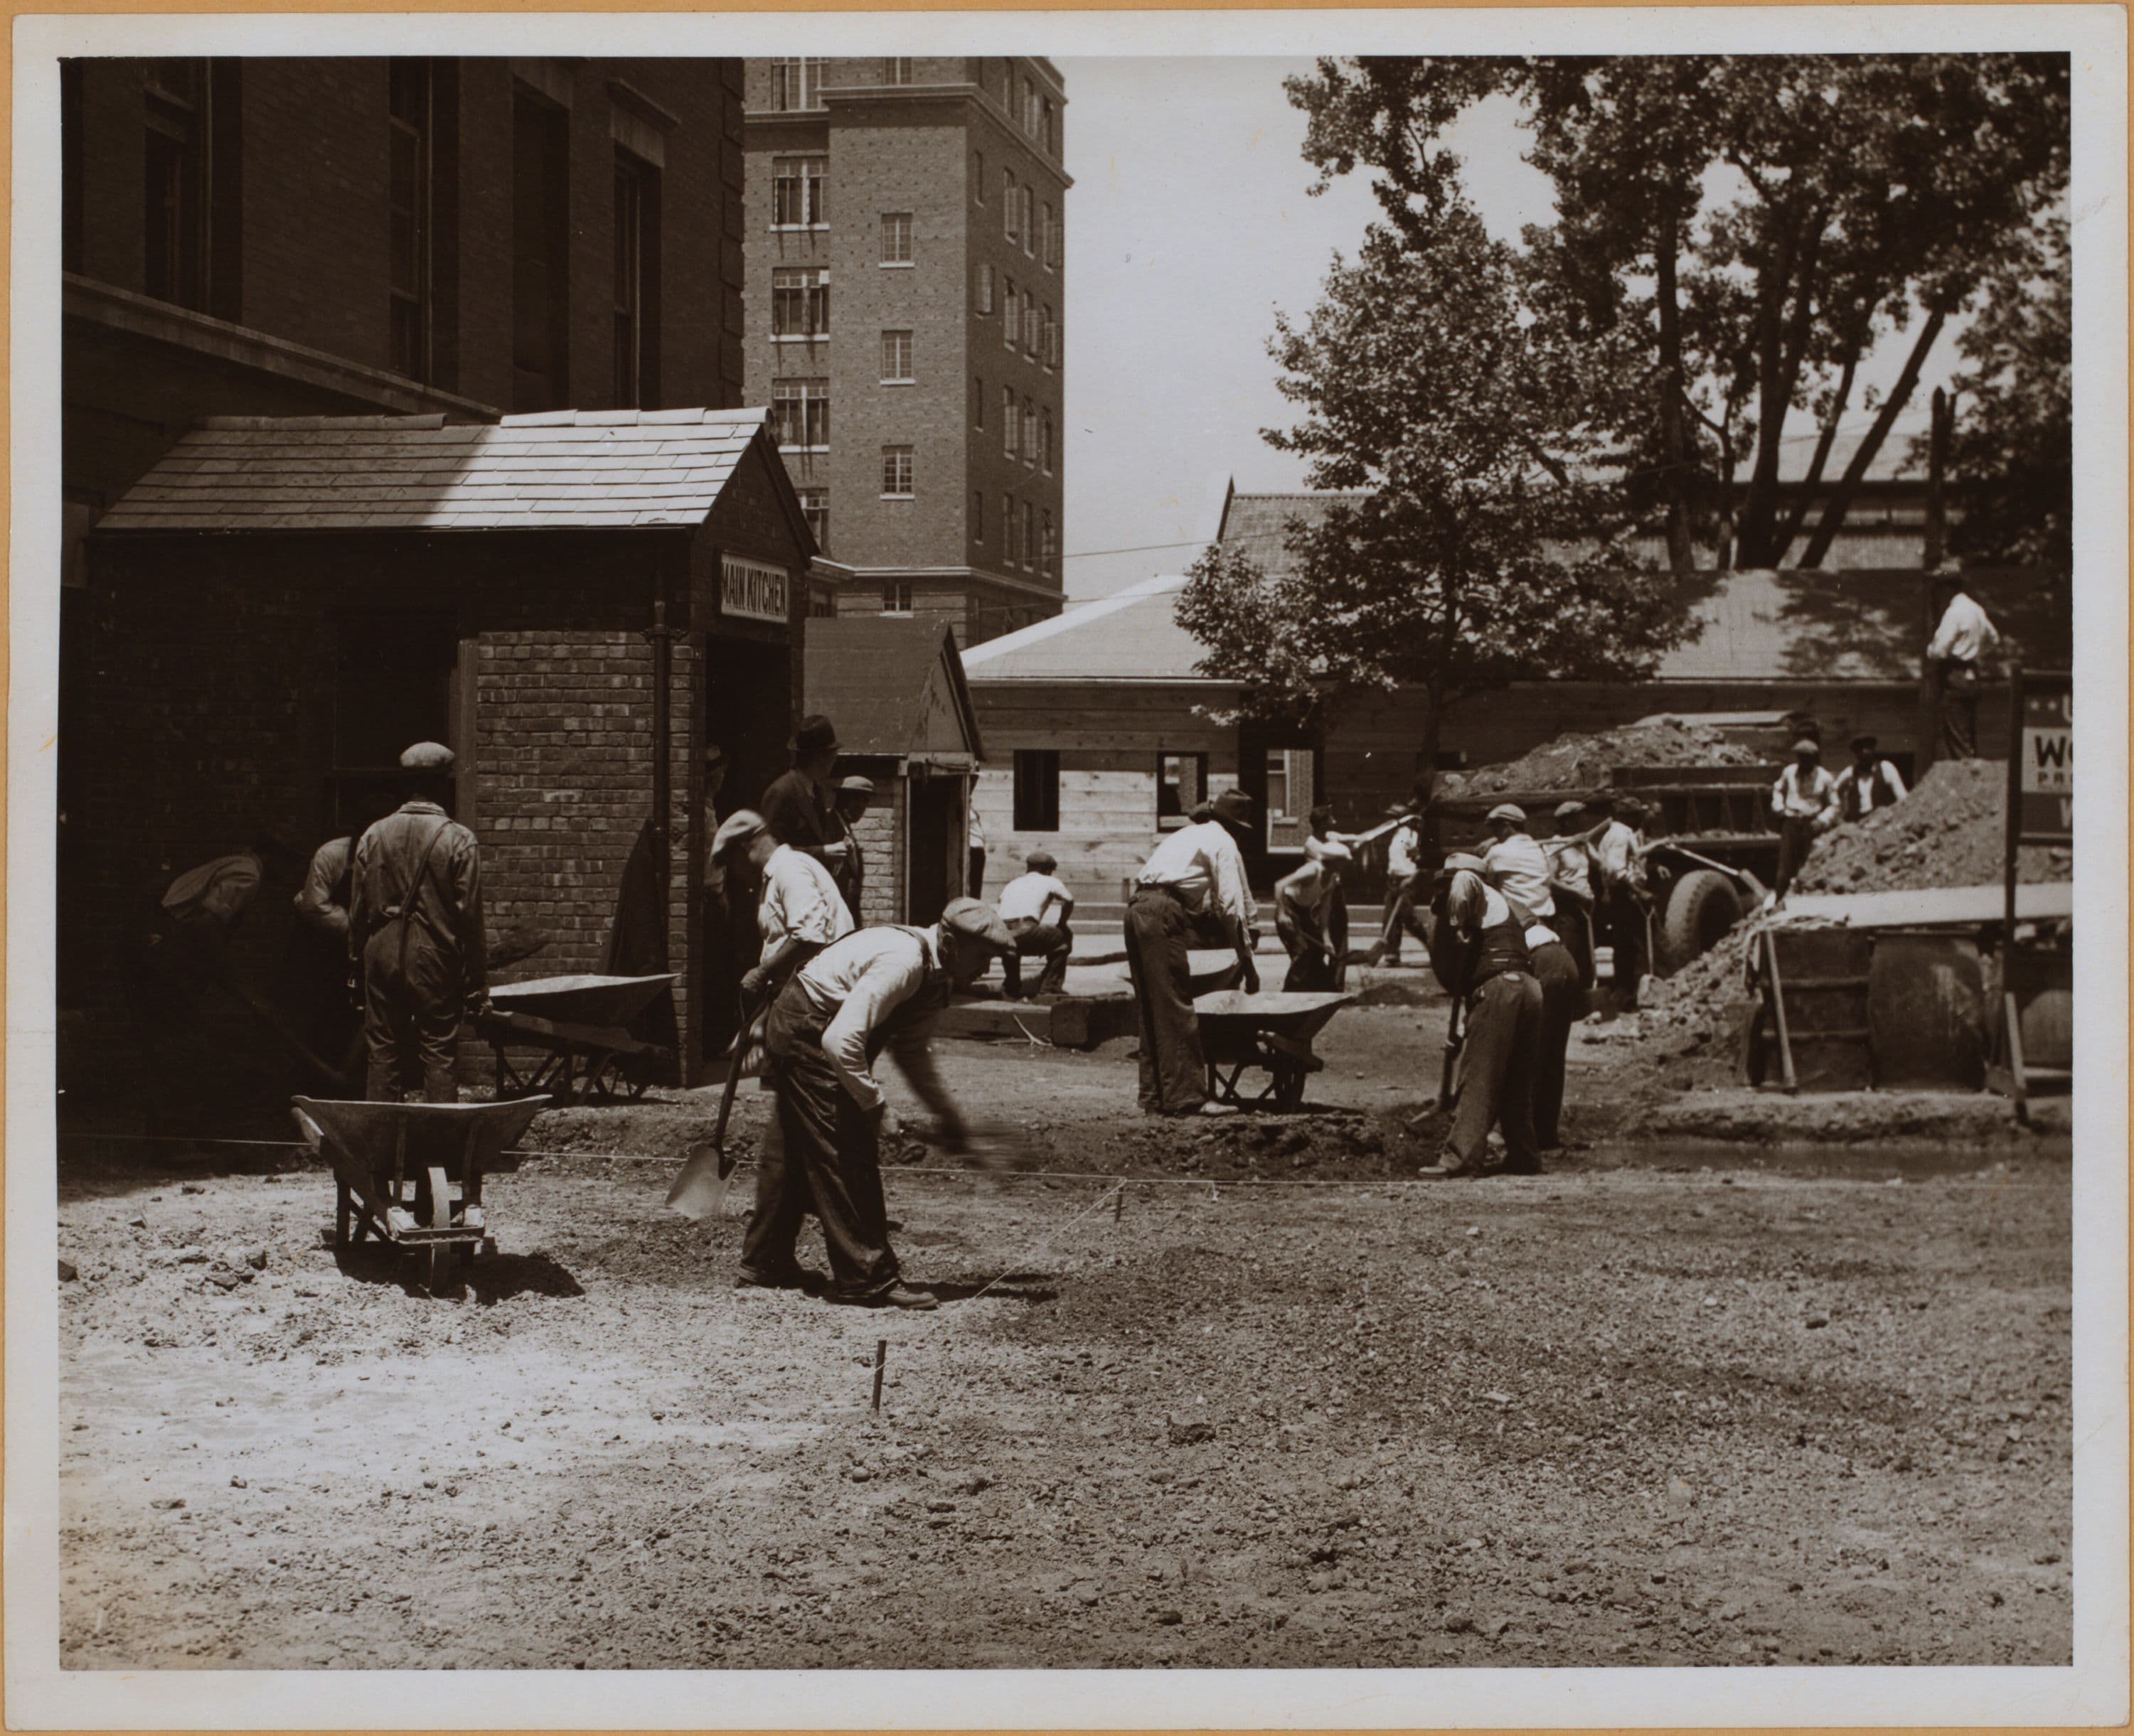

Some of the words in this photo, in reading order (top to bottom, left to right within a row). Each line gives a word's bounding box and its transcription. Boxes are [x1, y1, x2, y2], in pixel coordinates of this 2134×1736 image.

[722, 562, 745, 610] MAIN
[747, 568, 786, 616] KITCHEN
[2034, 735, 2072, 767] W
[2038, 771, 2072, 784] PR
